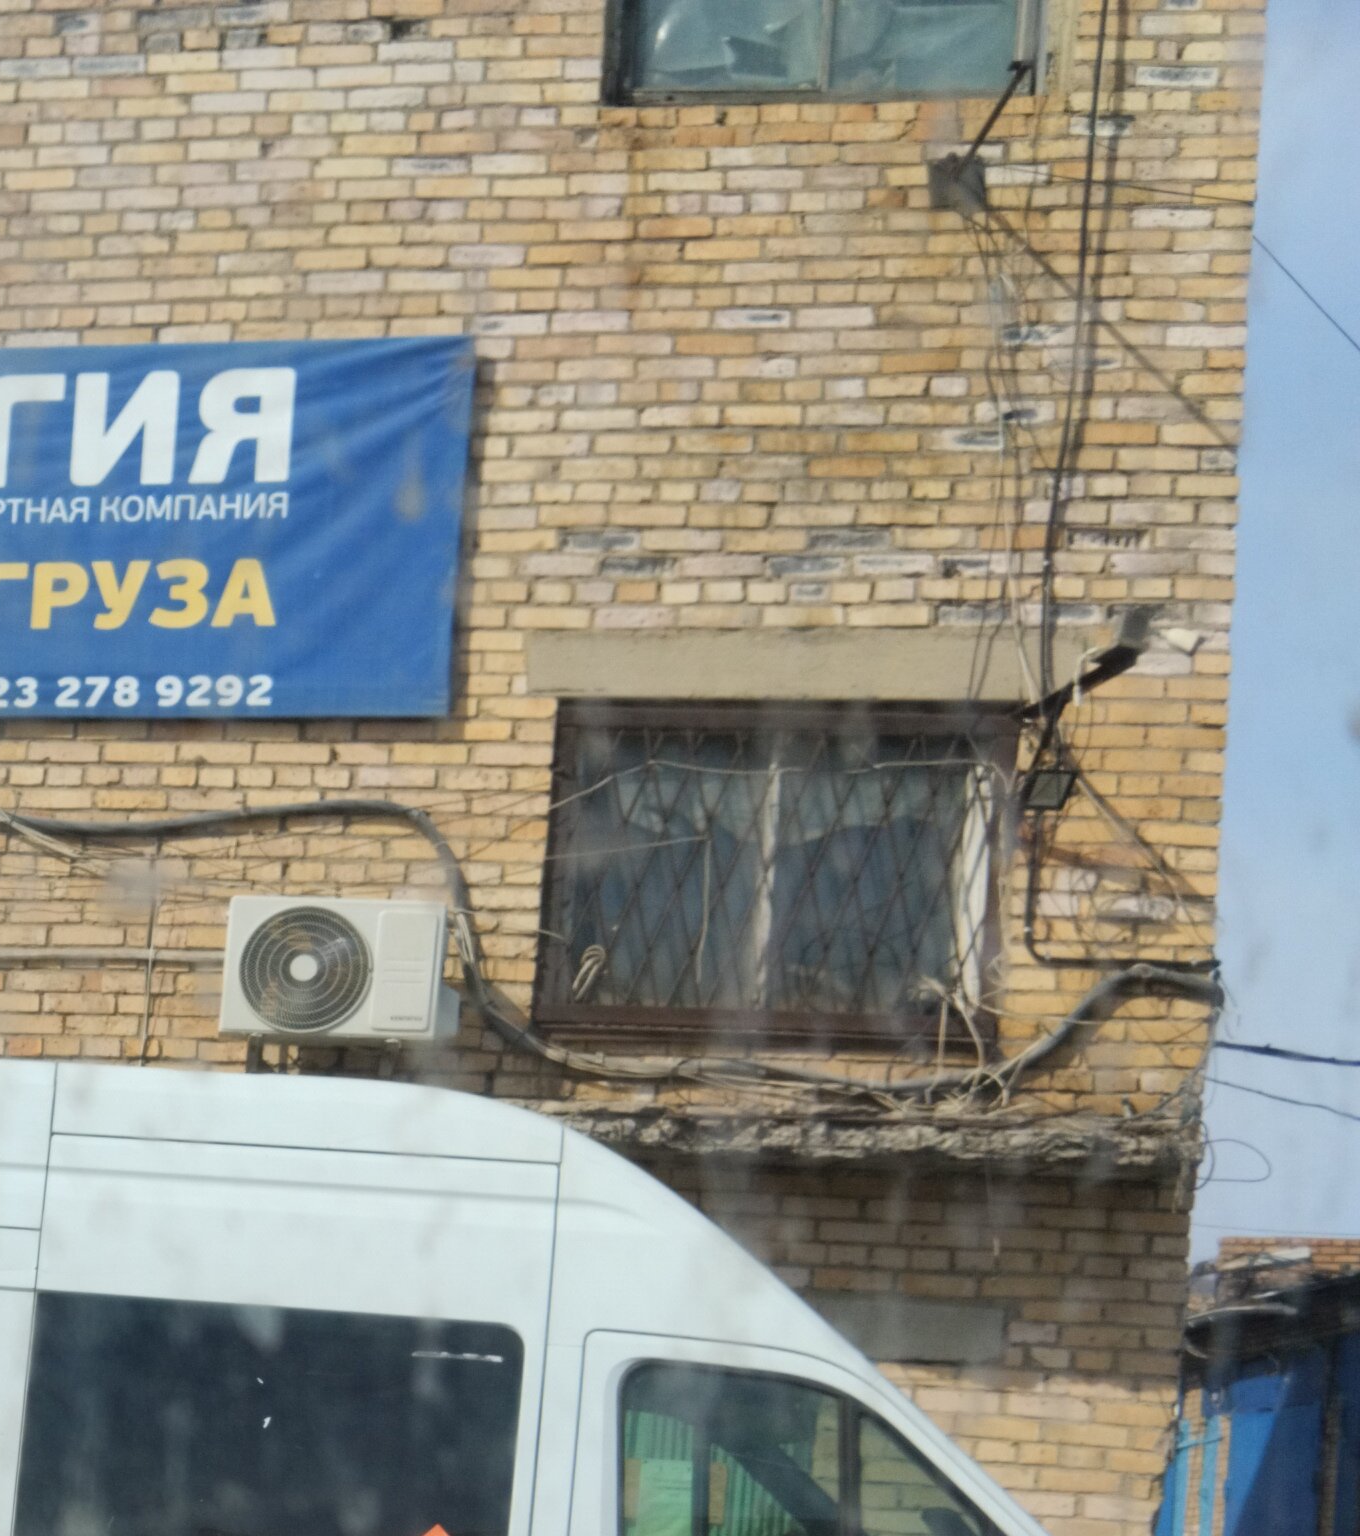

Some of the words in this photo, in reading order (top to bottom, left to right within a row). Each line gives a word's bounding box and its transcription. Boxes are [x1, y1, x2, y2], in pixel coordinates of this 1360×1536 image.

[99, 492, 289, 524] КОМПАНИЯ
[54, 676, 140, 708] 278
[155, 674, 273, 707] 9292
